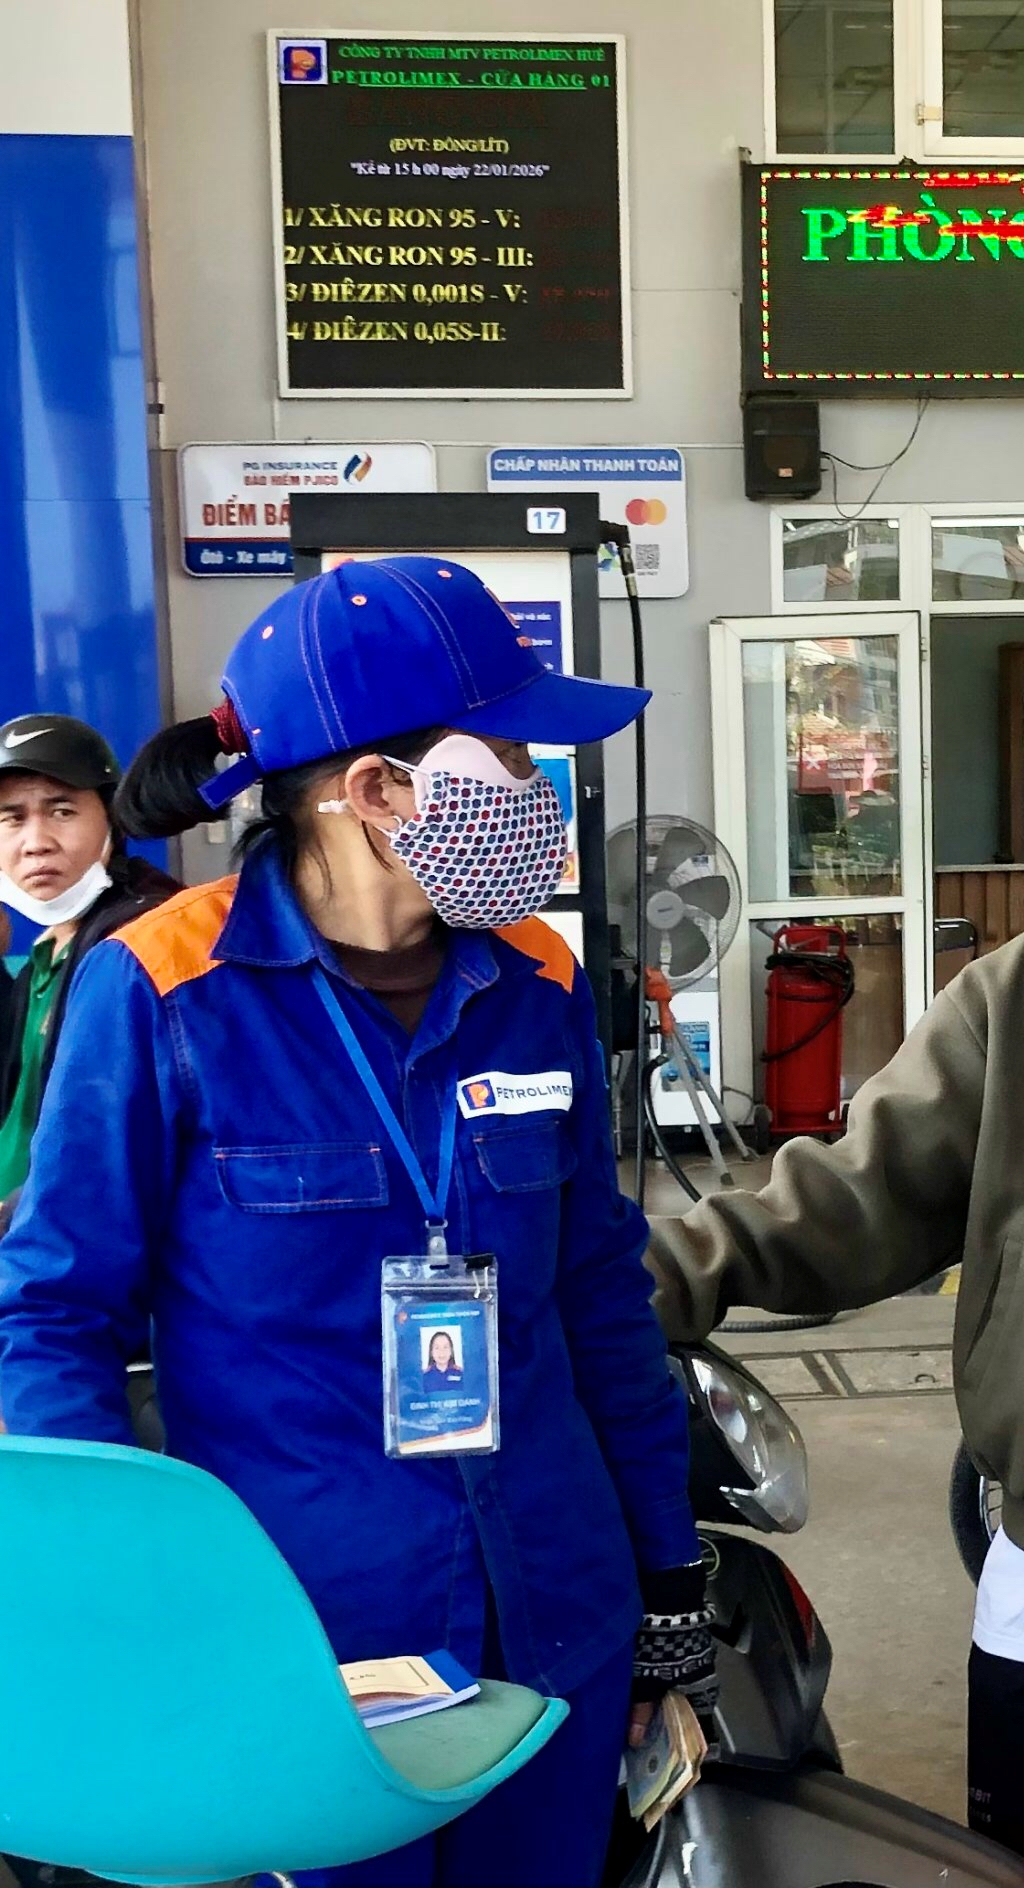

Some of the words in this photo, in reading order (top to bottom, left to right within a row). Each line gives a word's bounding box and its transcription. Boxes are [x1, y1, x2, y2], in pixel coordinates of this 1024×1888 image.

[382, 46, 403, 59] TY
[482, 48, 575, 61] PETROLIMEX
[332, 70, 460, 86] PETROLIMEX
[528, 71, 585, 88] HÀNG
[591, 74, 610, 88] 01
[394, 162, 410, 175] 15
[422, 163, 440, 175] 00
[308, 203, 383, 228] XĂNG
[387, 207, 444, 228] RON
[448, 208, 477, 228] 95
[494, 208, 521, 229] V:
[309, 241, 384, 266] XĂNG
[388, 246, 445, 266] RON
[449, 246, 478, 266] 95
[497, 246, 534, 267] III:
[412, 283, 486, 307] 0,001S
[502, 284, 529, 304] V:
[262, 461, 338, 471] INSURANCE
[494, 456, 535, 472] CHẤP
[537, 459, 581, 475] NHẬN
[582, 459, 636, 472] THANH
[203, 494, 257, 526] ĐIỂM
[533, 511, 560, 530] 17
